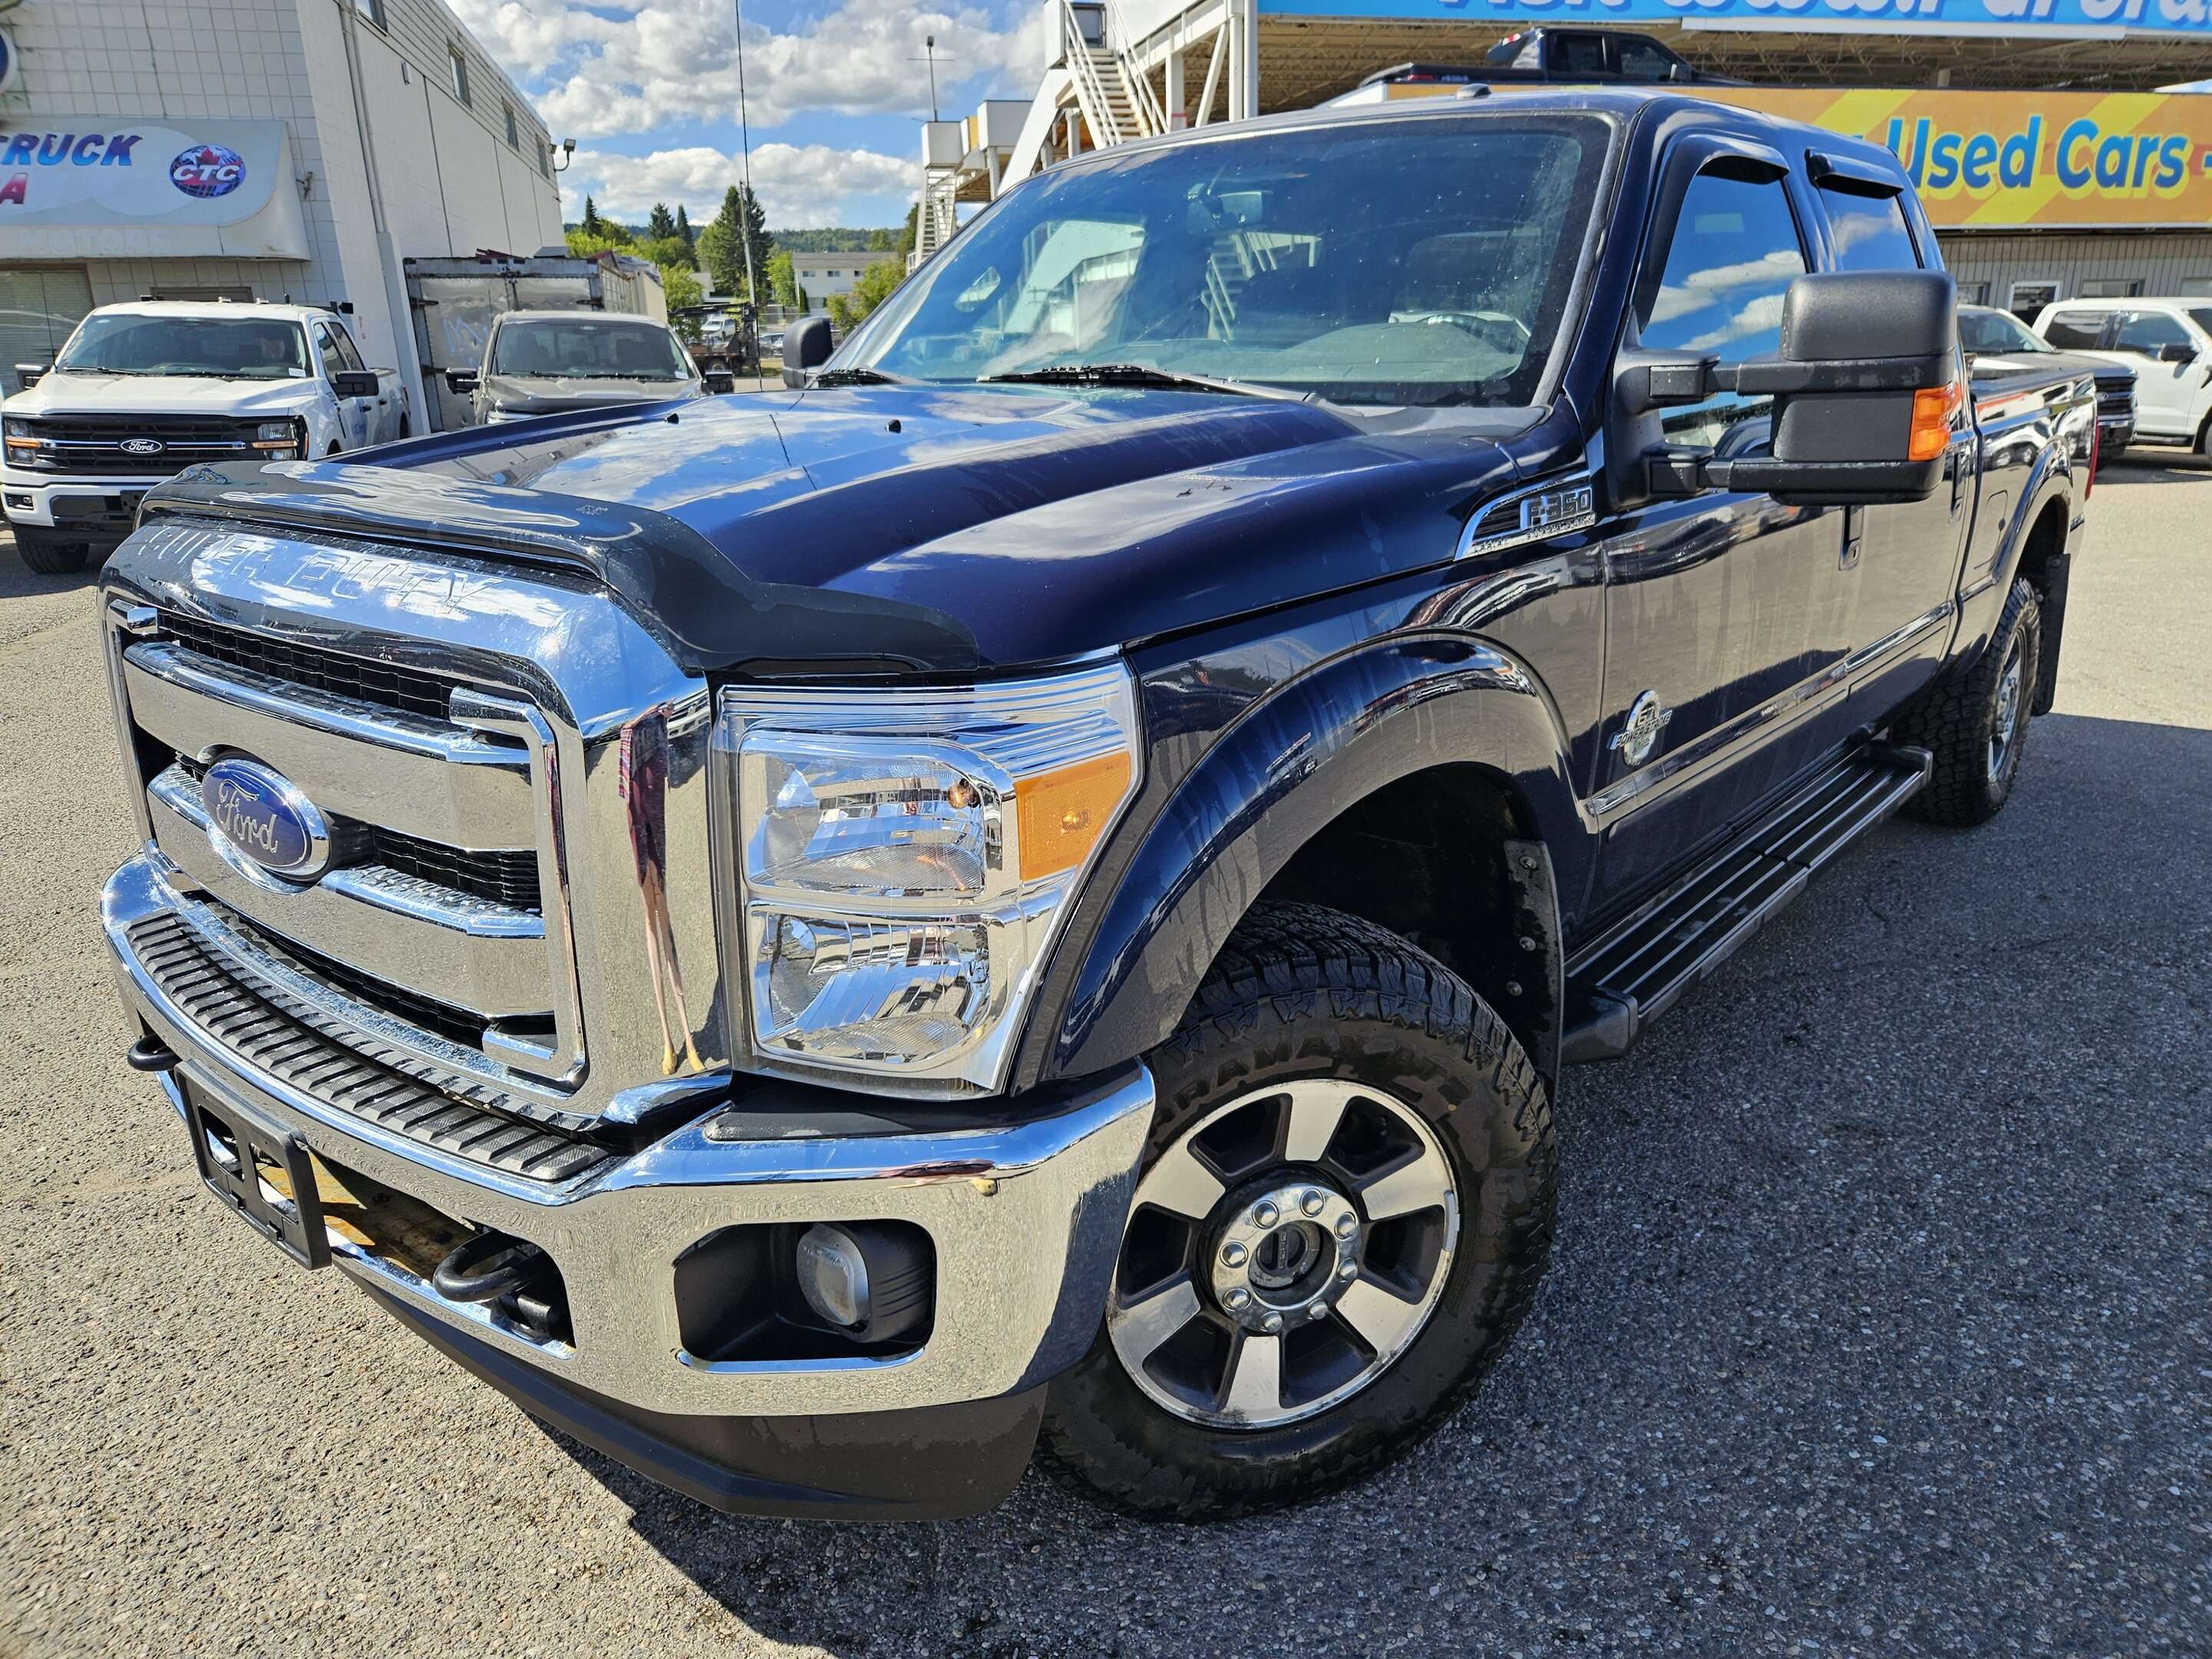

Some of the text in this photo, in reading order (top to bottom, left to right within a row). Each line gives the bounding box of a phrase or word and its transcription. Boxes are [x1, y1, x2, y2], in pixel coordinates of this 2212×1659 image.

[173, 164, 240, 181] CTC
[1885, 114, 2189, 189] Used Cars
[128, 441, 154, 451] Ford
[284, 550, 504, 614] DUTY
[216, 779, 279, 853] Ford
[1277, 1230, 1288, 1270] FORD
